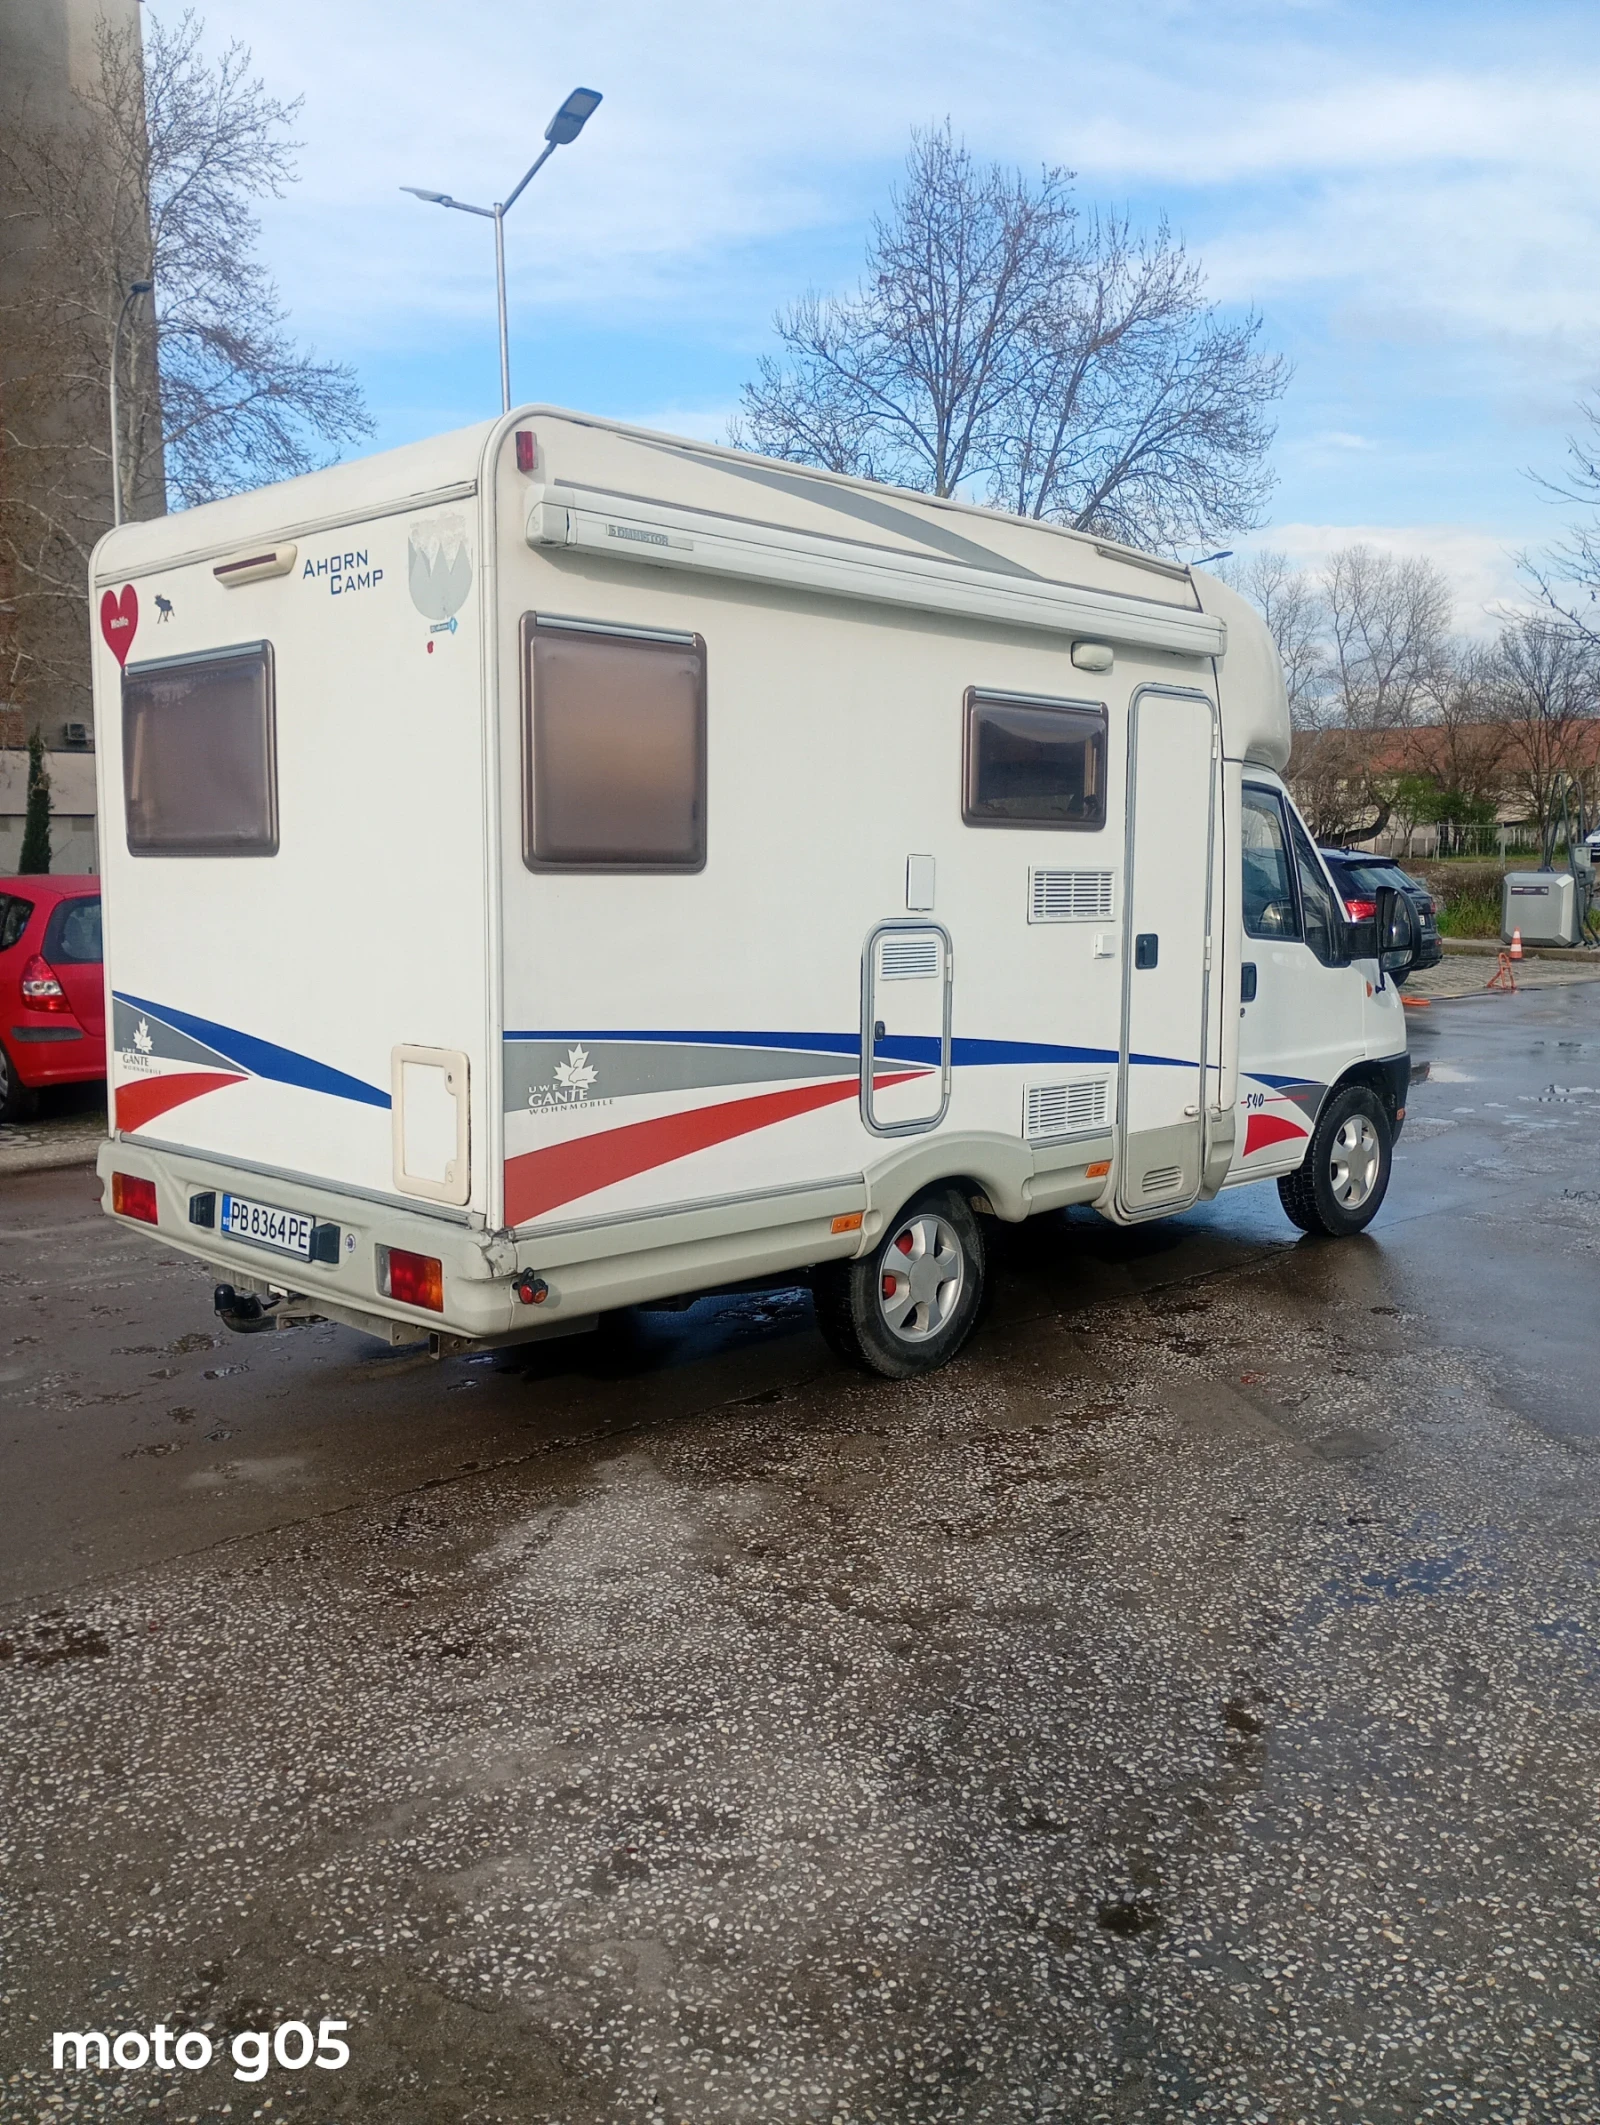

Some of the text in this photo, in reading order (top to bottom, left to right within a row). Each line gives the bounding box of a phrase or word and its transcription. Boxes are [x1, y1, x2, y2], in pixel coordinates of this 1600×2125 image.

[303, 549, 368, 580] AHORN
[330, 569, 384, 595] CAMP
[122, 1054, 149, 1066] GANTE
[528, 1083, 560, 1094] UWE
[528, 1088, 589, 1107] GANTE
[1246, 1093, 1265, 1110] 540
[528, 1098, 614, 1115] WOHNMOBILE
